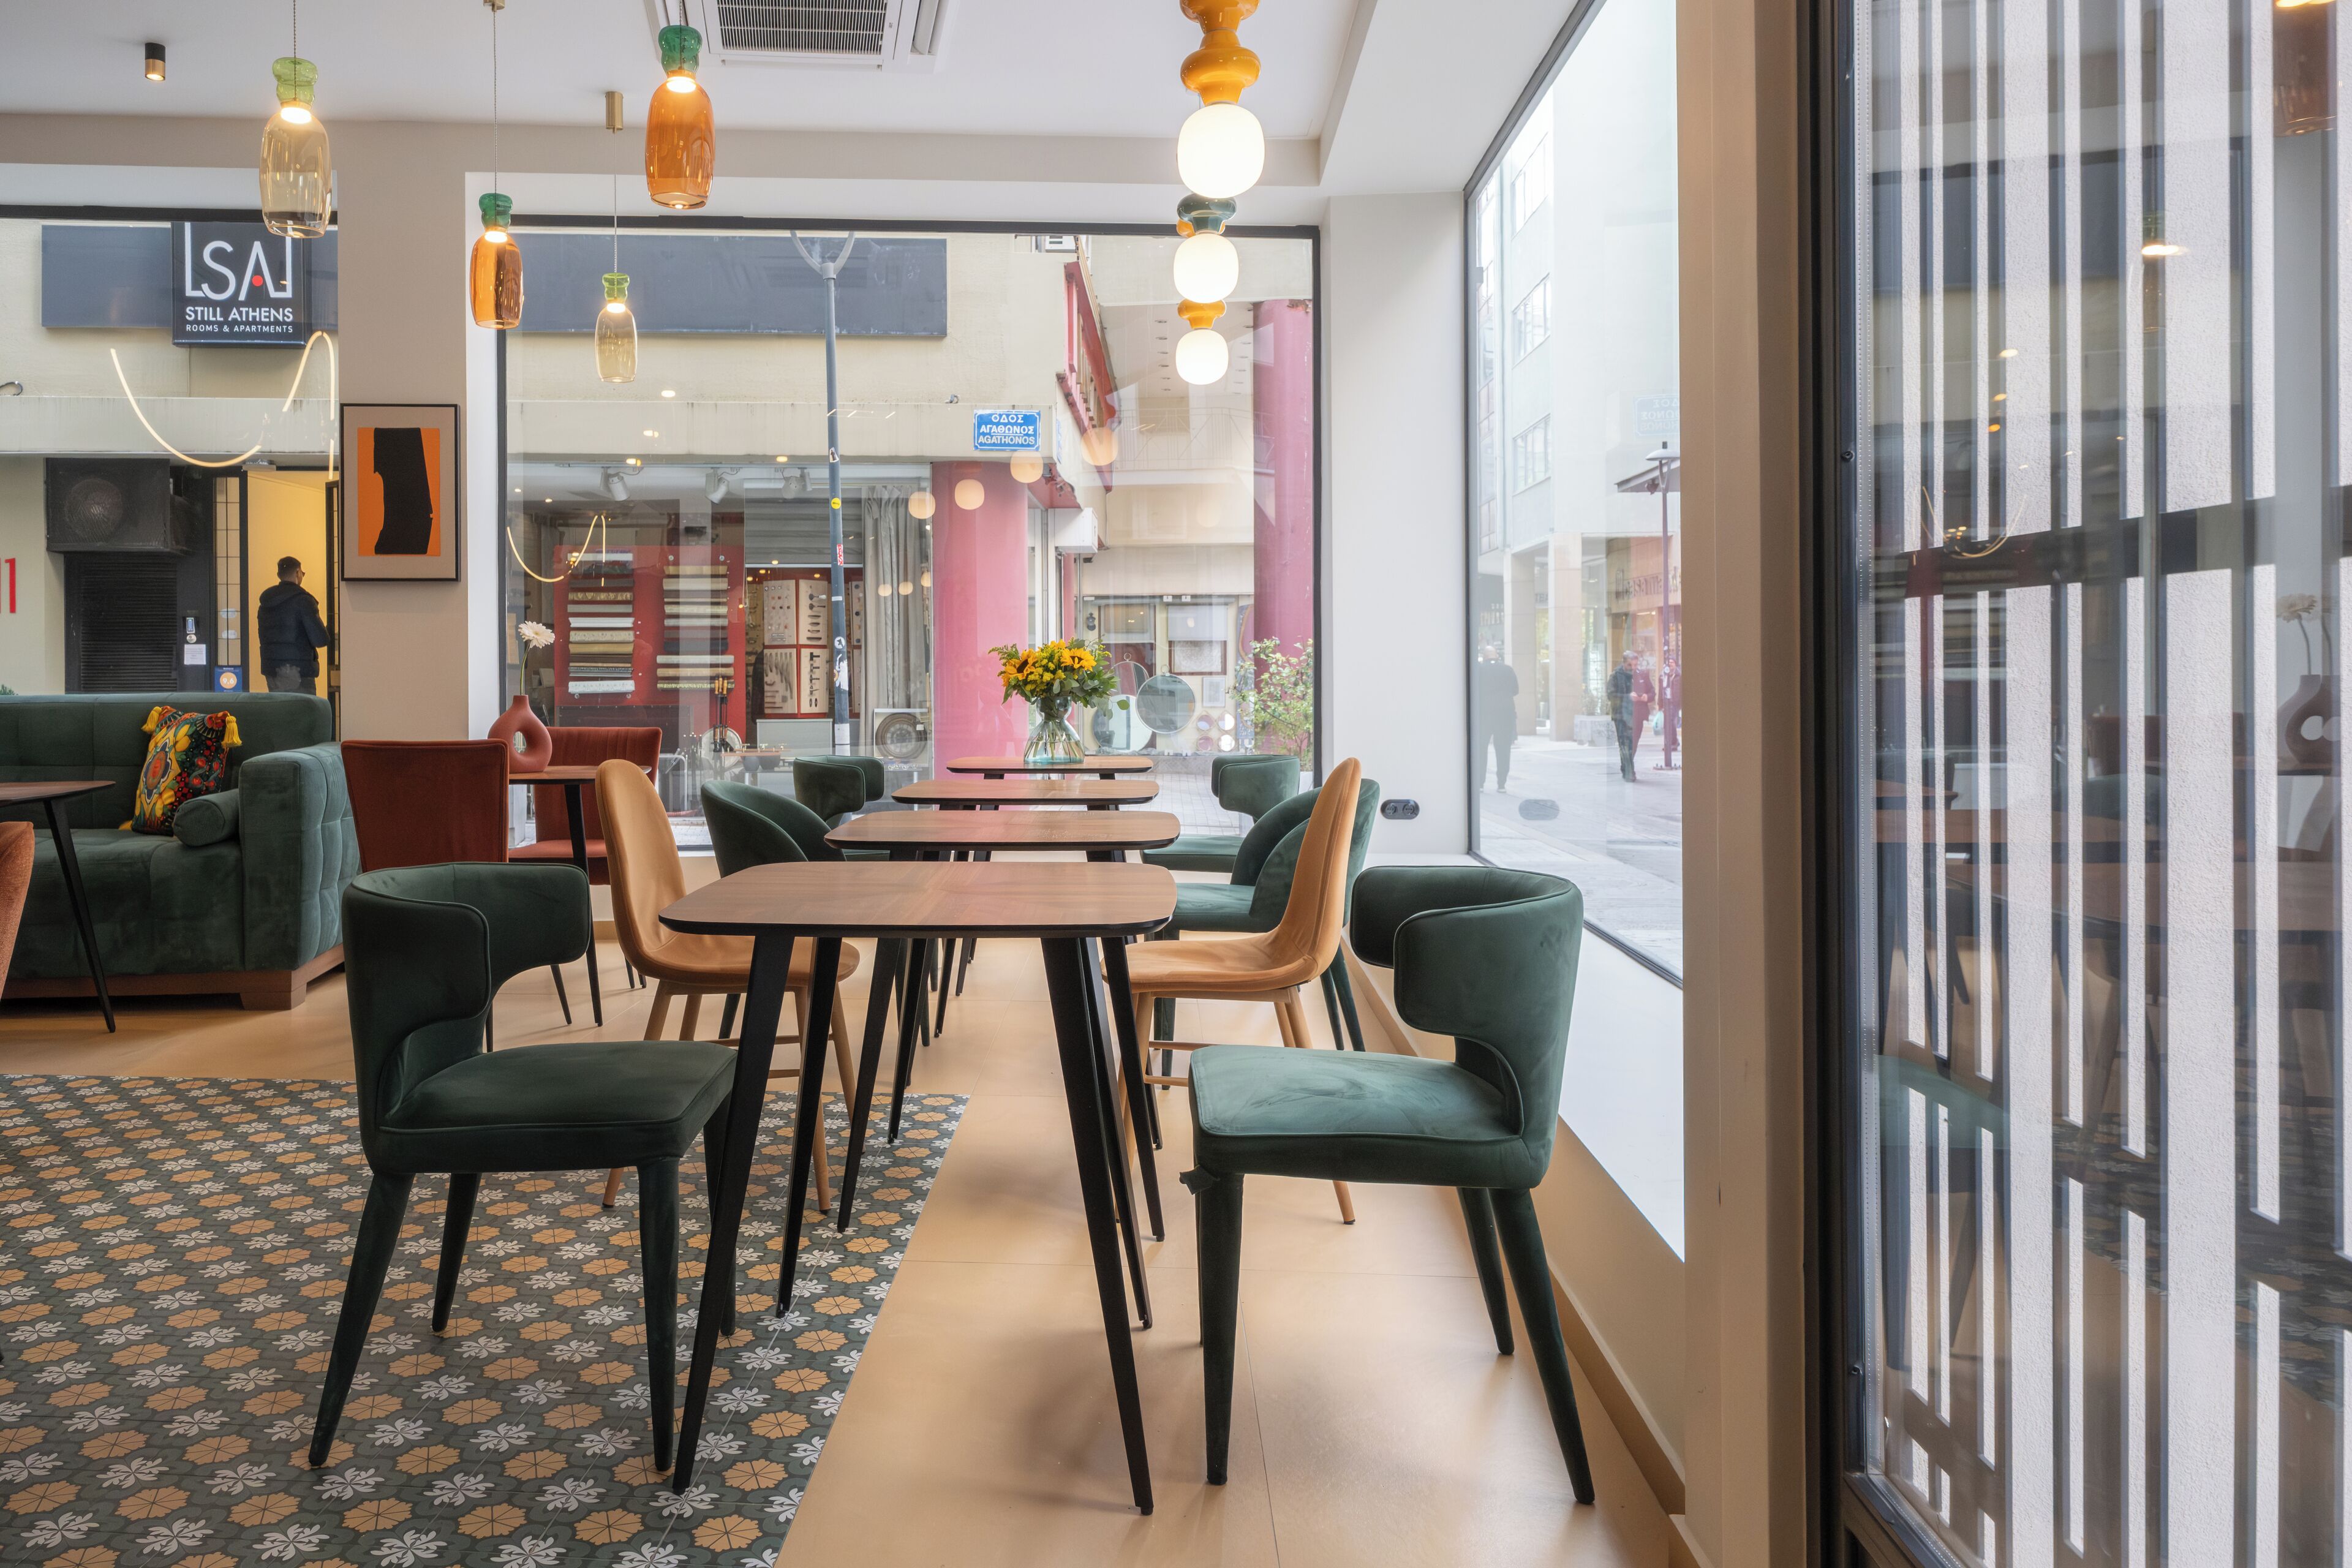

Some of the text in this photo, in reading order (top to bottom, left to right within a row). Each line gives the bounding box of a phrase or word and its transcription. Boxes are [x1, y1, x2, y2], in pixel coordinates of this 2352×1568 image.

[186, 307, 293, 322] STILL ATHENS
[980, 424, 1035, 434] ΑΓΑΘΩΝΟΣ
[978, 435, 1035, 445] AGATHONOS
